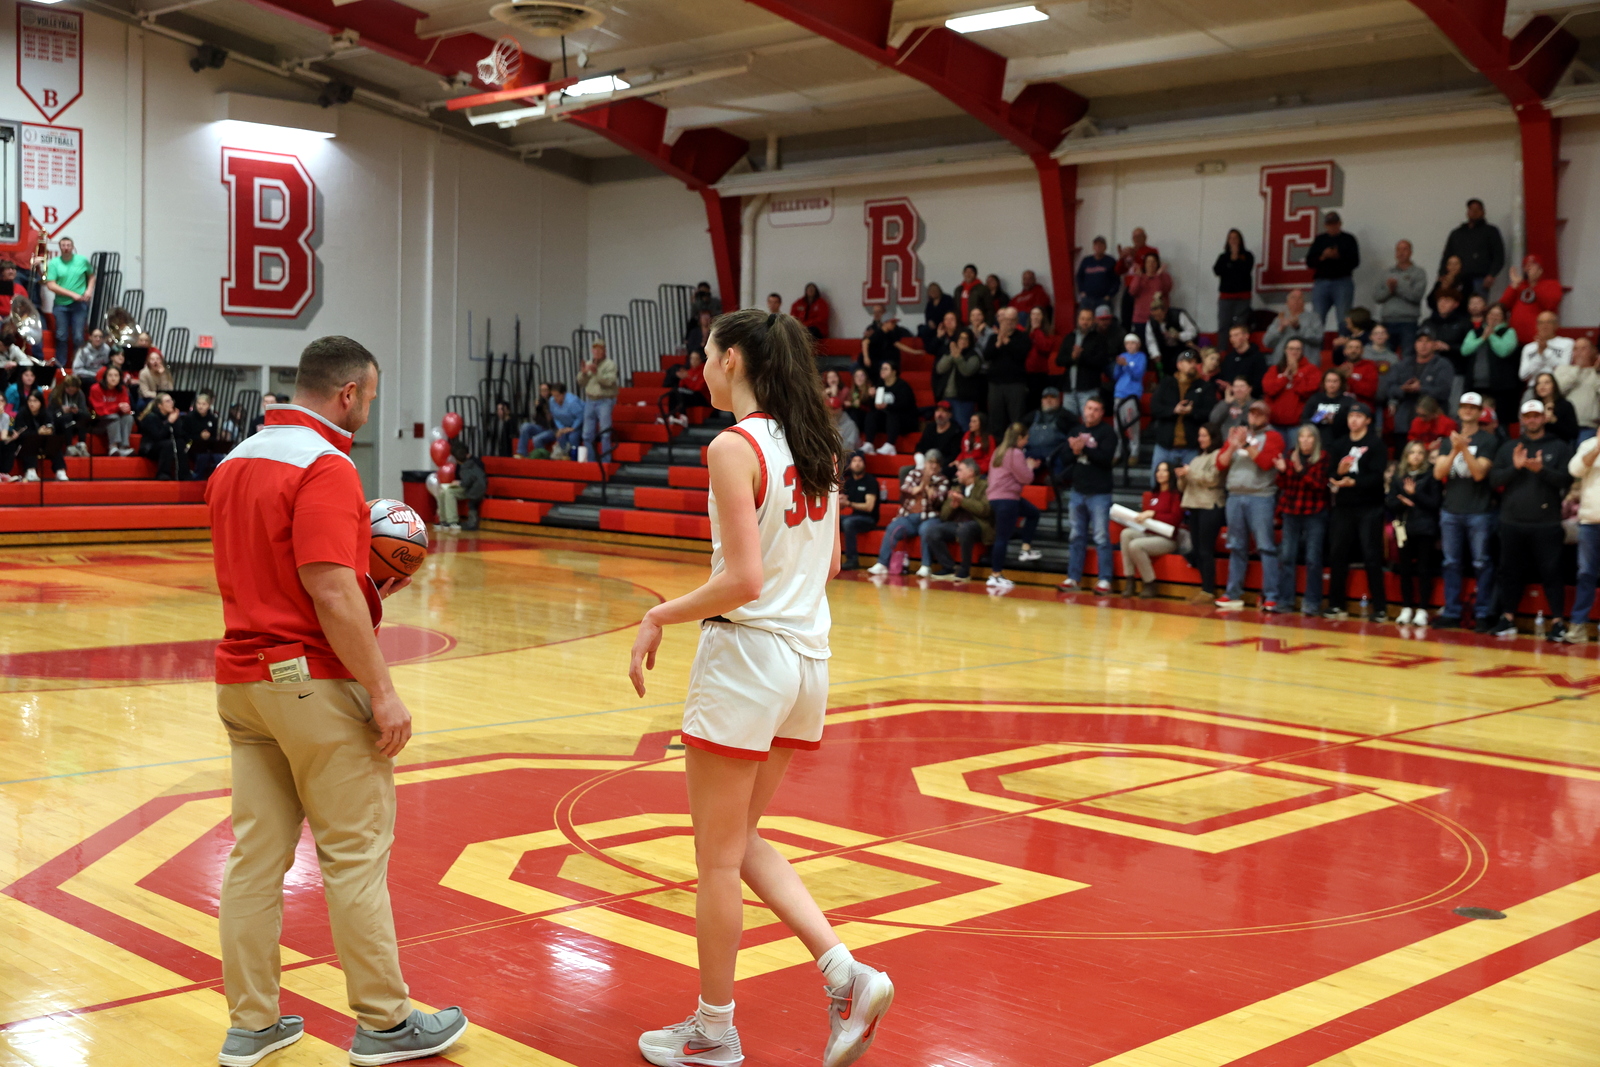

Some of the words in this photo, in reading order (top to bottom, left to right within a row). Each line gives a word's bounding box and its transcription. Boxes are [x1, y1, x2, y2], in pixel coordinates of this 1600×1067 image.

[37, 16, 78, 31] VOLLEYBALL
[43, 88, 58, 108] B
[40, 135, 74, 147] SOFTBALL
[43, 206, 58, 224] B
[221, 146, 316, 319] B
[1256, 160, 1334, 292] E
[863, 196, 920, 306] R
[388, 510, 414, 524] 1000
